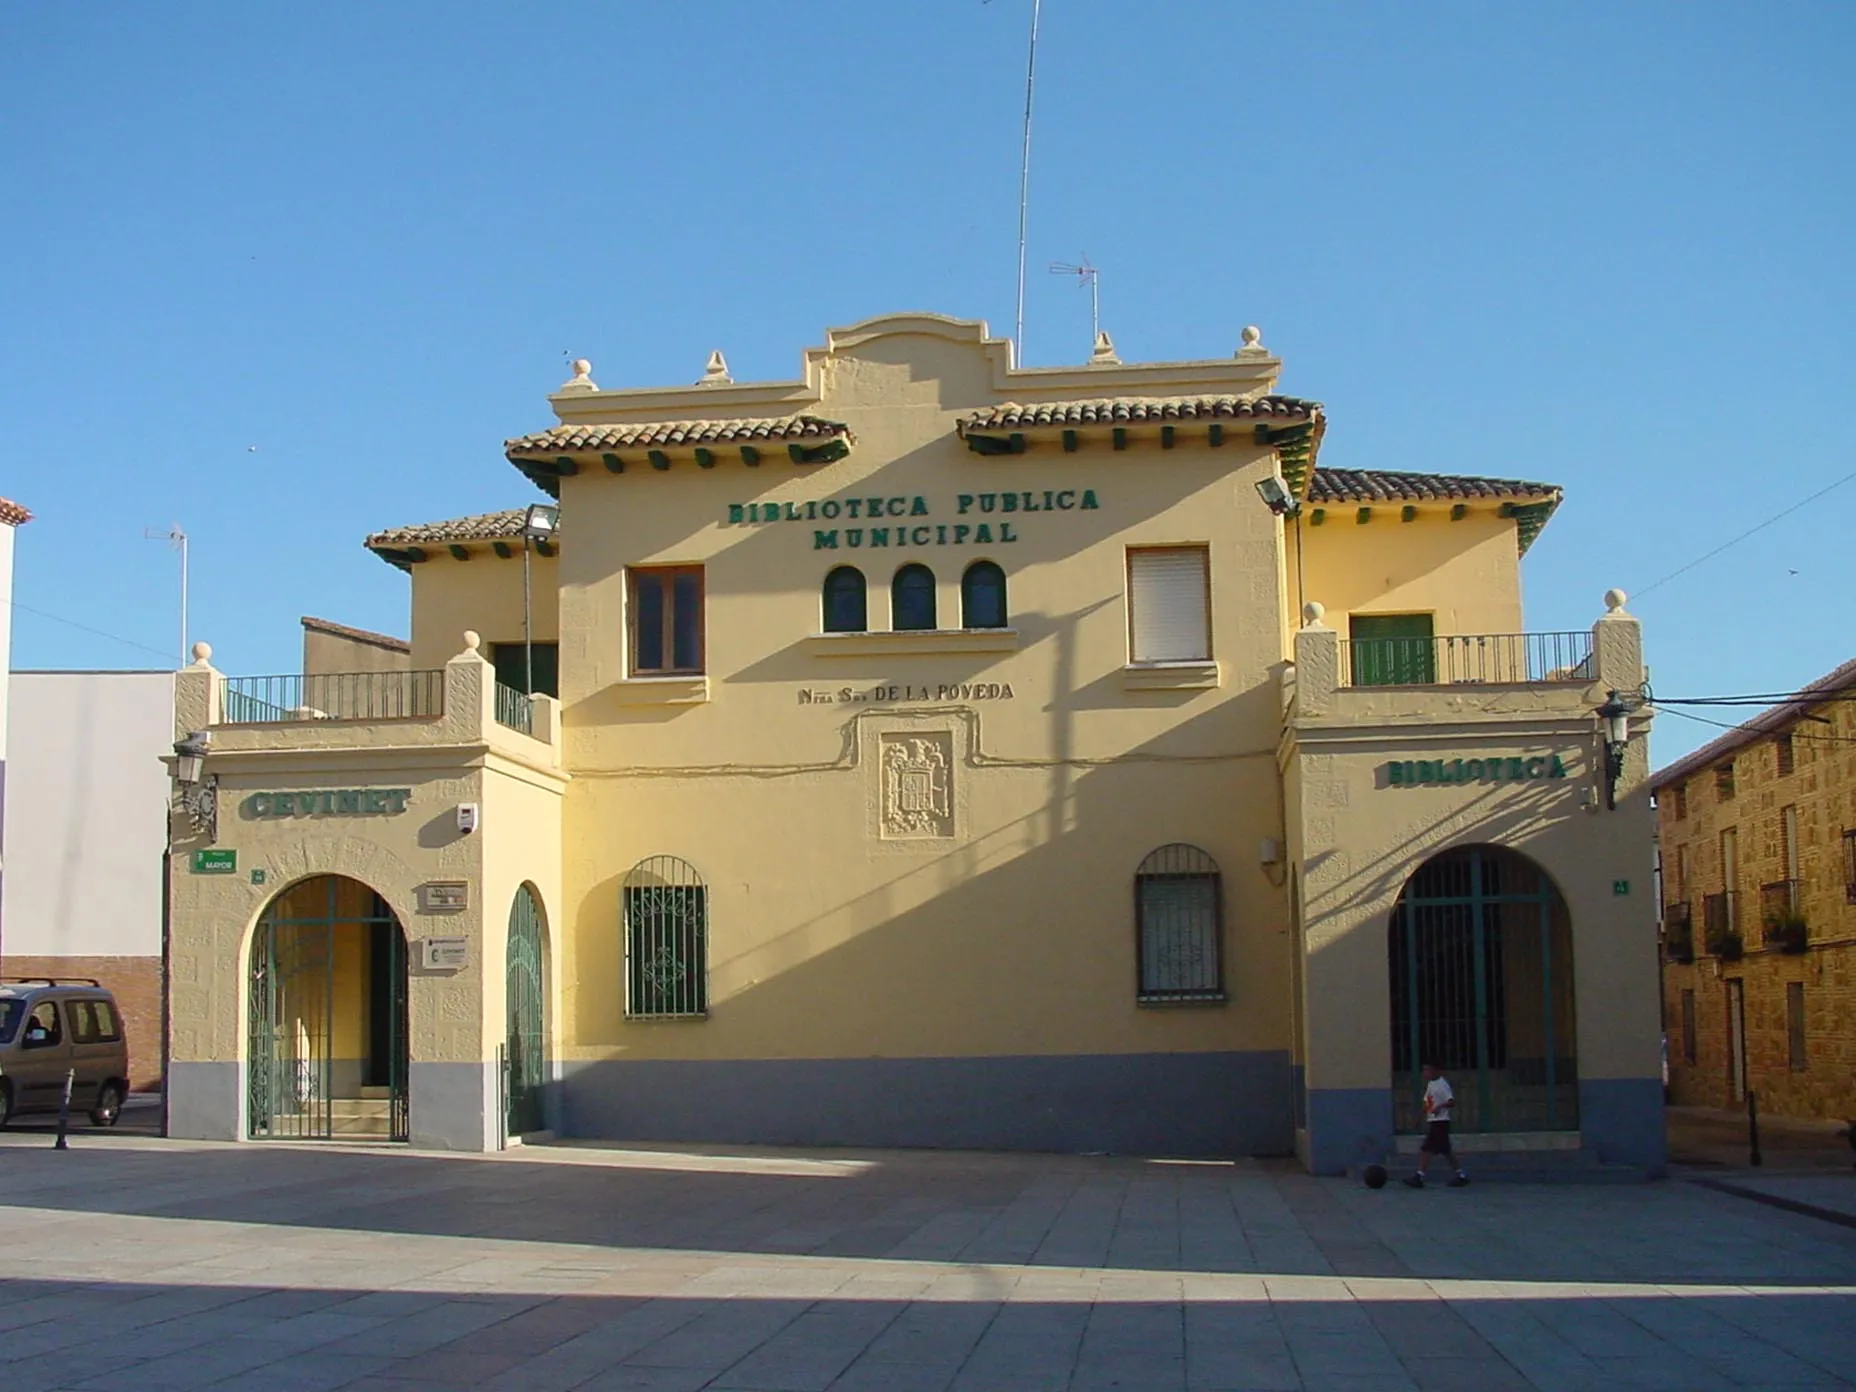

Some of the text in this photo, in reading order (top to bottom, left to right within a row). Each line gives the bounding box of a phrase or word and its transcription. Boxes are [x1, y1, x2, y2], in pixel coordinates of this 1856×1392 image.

[728, 489, 1100, 524] BIBLIOTECA PUBLICA
[814, 522, 1018, 550] MUNICIPAL
[875, 685, 900, 701] DE
[906, 685, 931, 700] LA
[938, 683, 1014, 700] POVEDA
[1387, 755, 1567, 784] BIBLIOTECA
[248, 788, 411, 816] CEVINET
[205, 861, 233, 869] MAYOR
